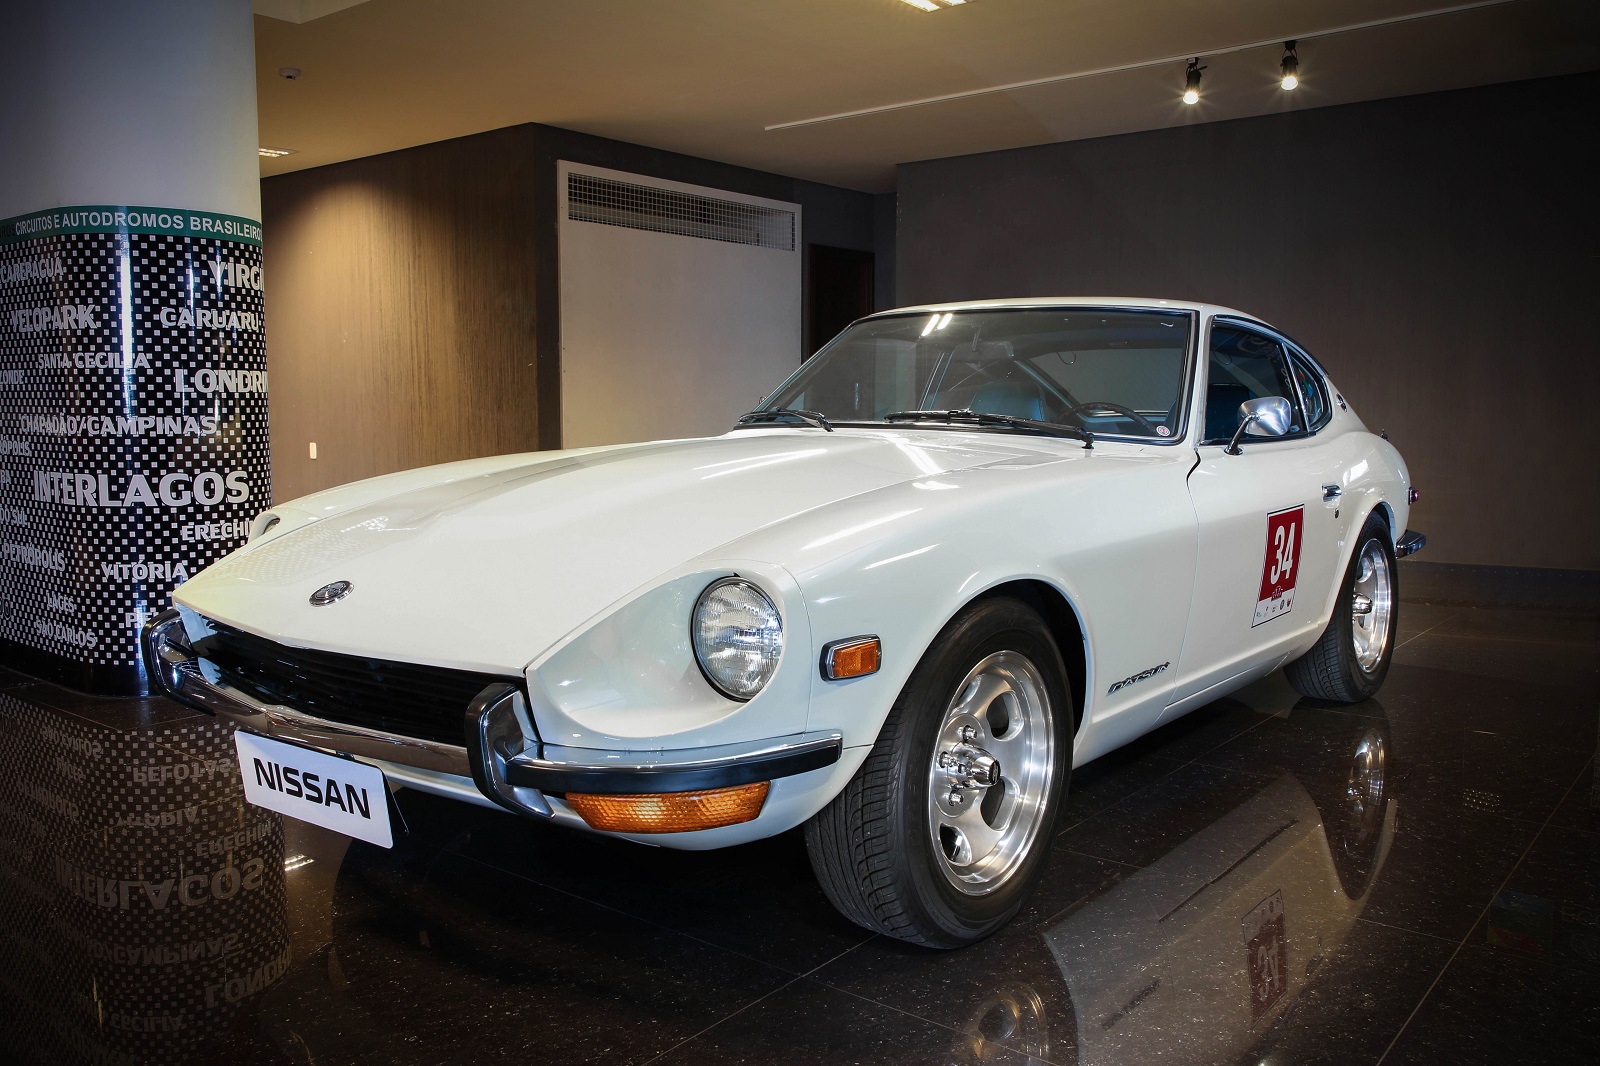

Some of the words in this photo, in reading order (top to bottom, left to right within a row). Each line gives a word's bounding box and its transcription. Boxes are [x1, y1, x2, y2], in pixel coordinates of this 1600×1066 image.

[15, 214, 53, 235] CIRCUITOS
[54, 214, 60, 228] E
[62, 212, 184, 229] AUTODROMOS
[0, 251, 64, 283] CAREPAGUÁ
[11, 304, 97, 332] VELOPARK
[160, 308, 259, 331] CARUARU
[38, 353, 70, 369] SANTA
[74, 352, 150, 369] CECILA
[0, 436, 30, 456] ÓPOLIS
[34, 469, 249, 507] INTERLAGOS
[181, 521, 253, 540] ERECHI
[3, 541, 65, 571] PETRÓPOLIS
[1270, 522, 1296, 585] 34
[101, 559, 188, 581] VITÓRIA
[47, 592, 74, 613] LAGES
[35, 618, 54, 637] SÃO
[55, 624, 97, 648] CARLOS
[253, 757, 371, 820] NISSAN
